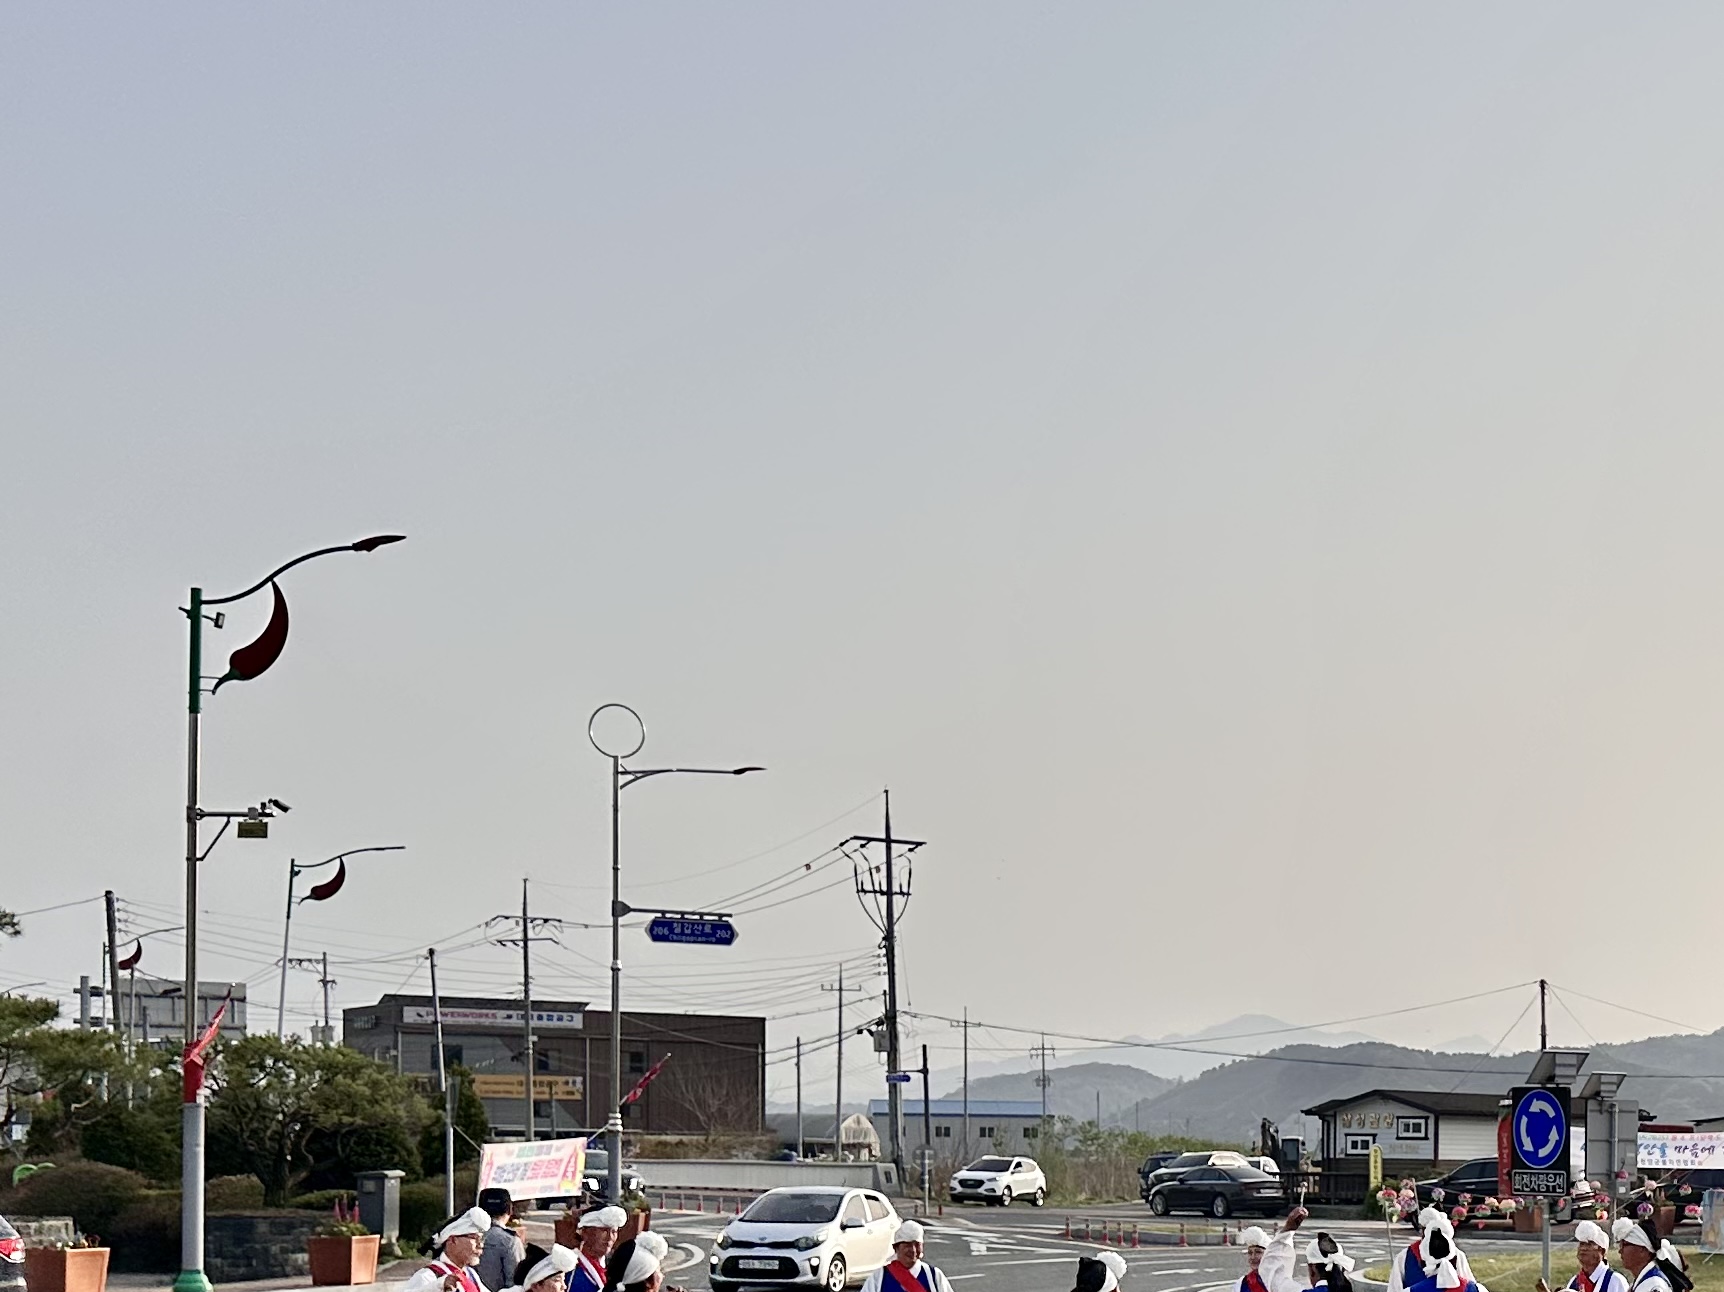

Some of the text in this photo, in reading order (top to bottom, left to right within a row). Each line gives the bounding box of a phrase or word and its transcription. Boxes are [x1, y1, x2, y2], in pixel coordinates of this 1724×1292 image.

[672, 922, 712, 934] 칠갑산로
[426, 1011, 498, 1020] PWERWORKS
[1637, 1141, 1669, 1158] 안을
[1674, 1143, 1716, 1159] 마음에
[1513, 1173, 1564, 1192] 회전차량우선
